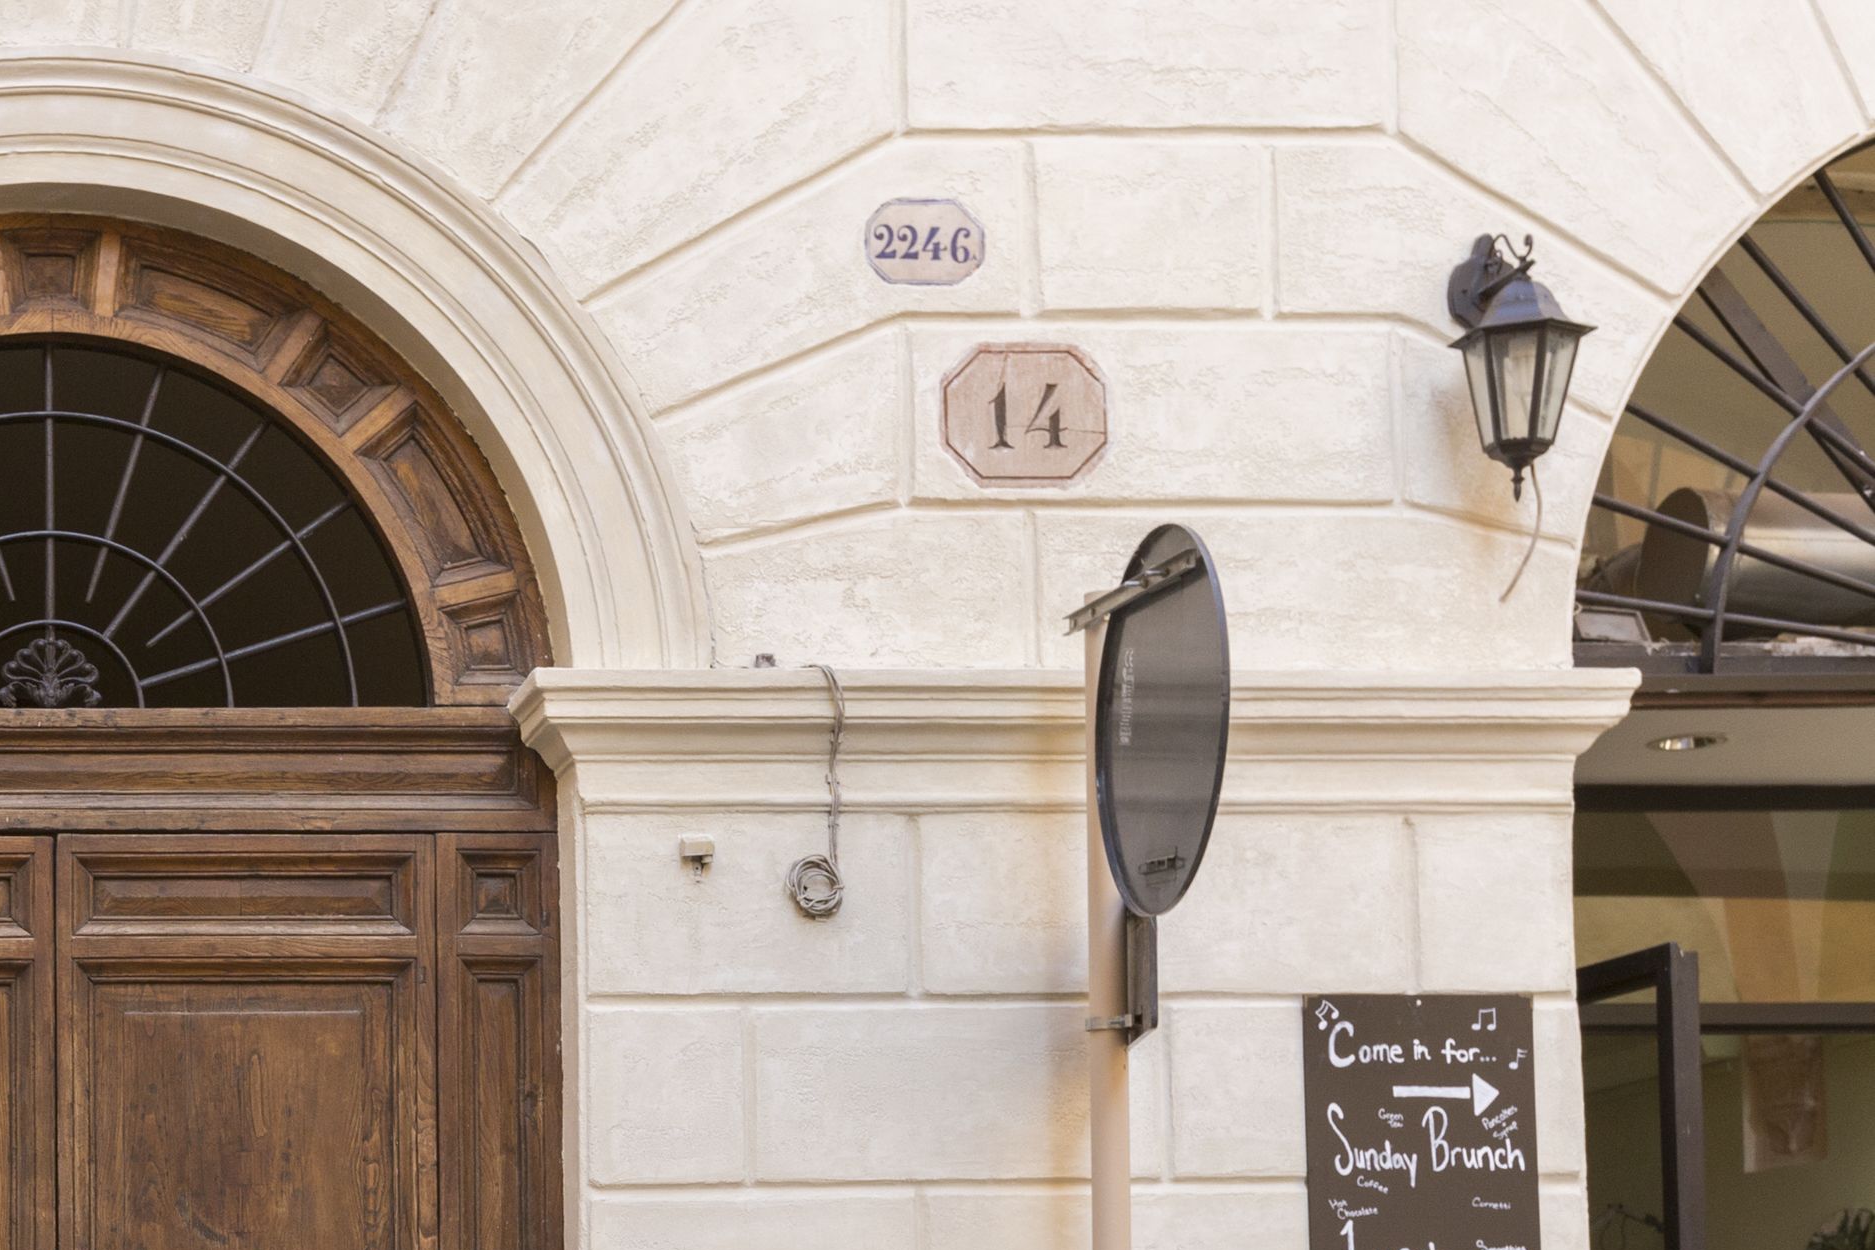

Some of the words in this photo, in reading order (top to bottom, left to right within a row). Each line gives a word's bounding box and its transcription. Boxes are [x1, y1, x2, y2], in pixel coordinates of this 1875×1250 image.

[987, 382, 1069, 450] 14
[1328, 1020, 1405, 1068] Come
[1413, 1038, 1432, 1061] in
[1327, 1102, 1418, 1189] Sunday
[1422, 1105, 1526, 1172] Brunch
[1356, 1175, 1389, 1195] Coffee
